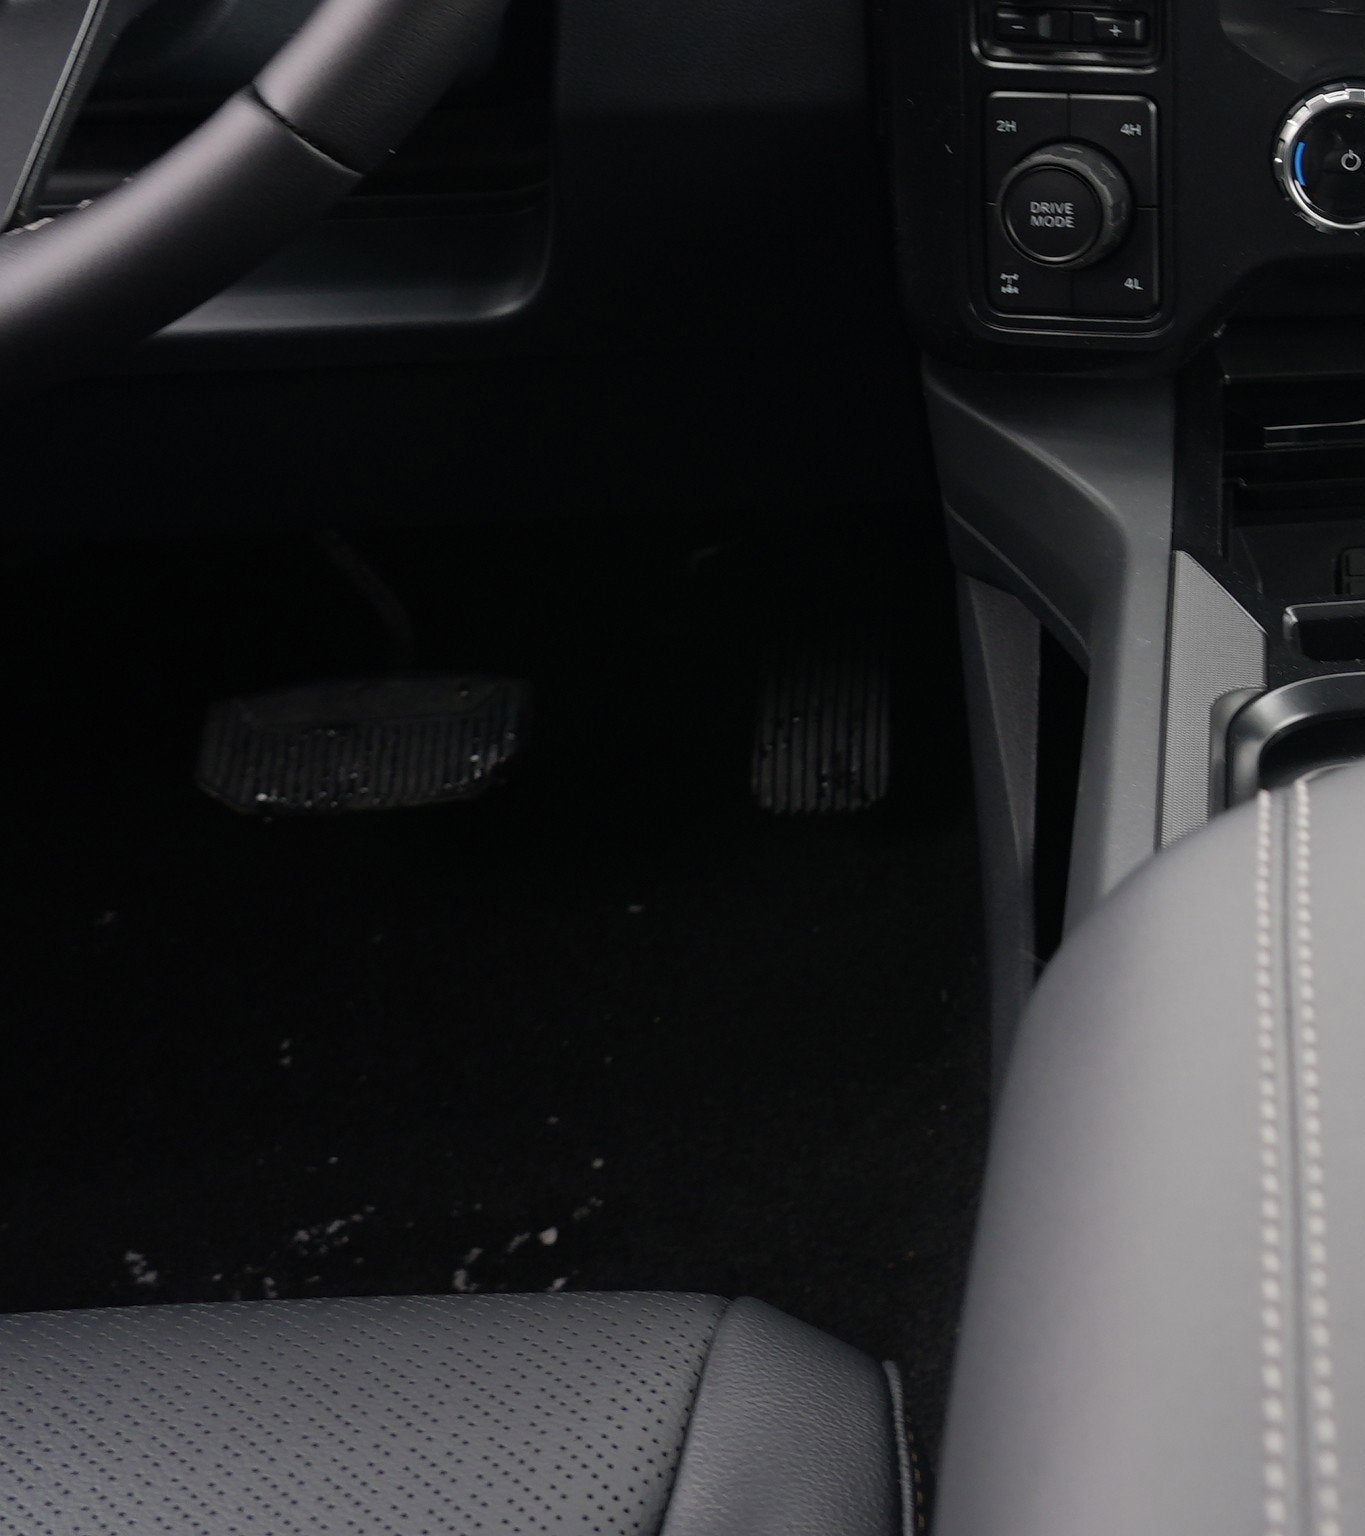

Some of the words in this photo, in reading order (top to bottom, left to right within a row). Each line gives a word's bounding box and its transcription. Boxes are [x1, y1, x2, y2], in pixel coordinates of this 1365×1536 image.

[996, 119, 1017, 133] 2H
[1119, 123, 1142, 137] 4H
[1029, 201, 1074, 215] DRIVE
[1030, 215, 1075, 229] MODE
[1123, 277, 1143, 291] 4L
